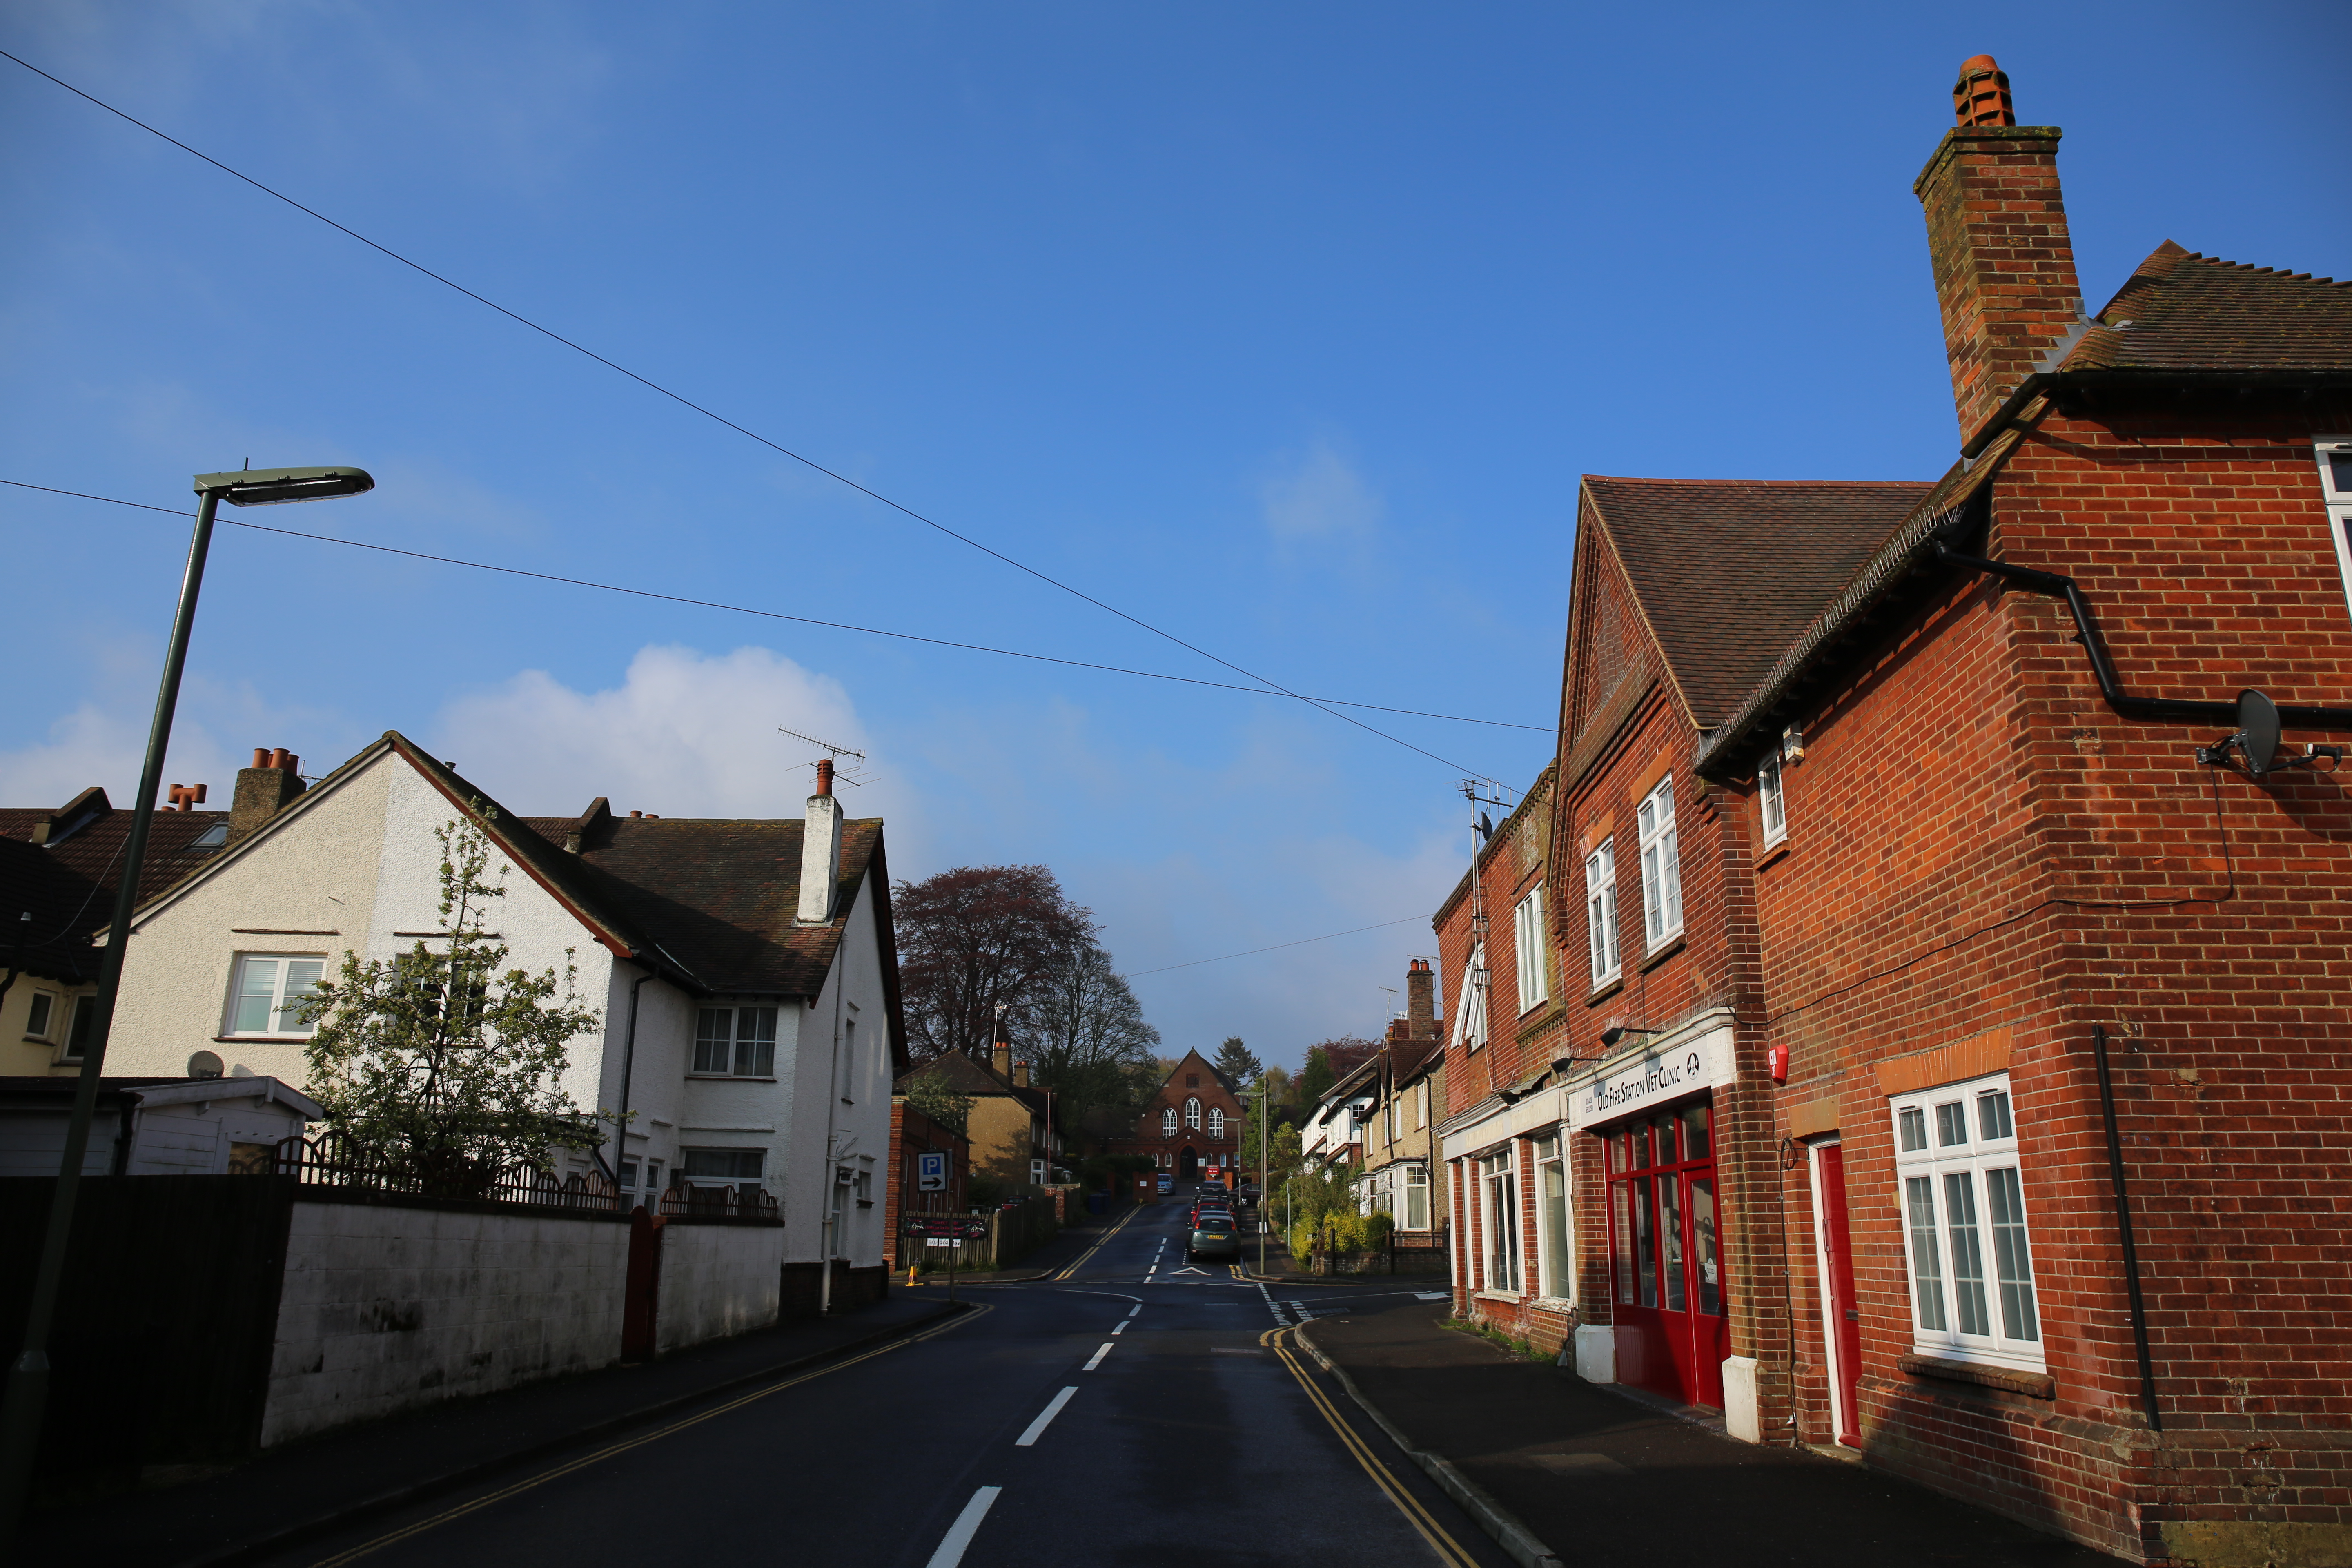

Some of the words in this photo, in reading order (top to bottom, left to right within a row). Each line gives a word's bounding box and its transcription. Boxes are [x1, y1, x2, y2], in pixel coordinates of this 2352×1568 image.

[1598, 1091, 1608, 1111] OLD
[1610, 1087, 1620, 1107] FIRE
[1621, 1079, 1645, 1102] STATION
[1646, 1071, 1657, 1093] VET
[1659, 1065, 1680, 1089] CLINIC
[927, 1159, 937, 1173] P
